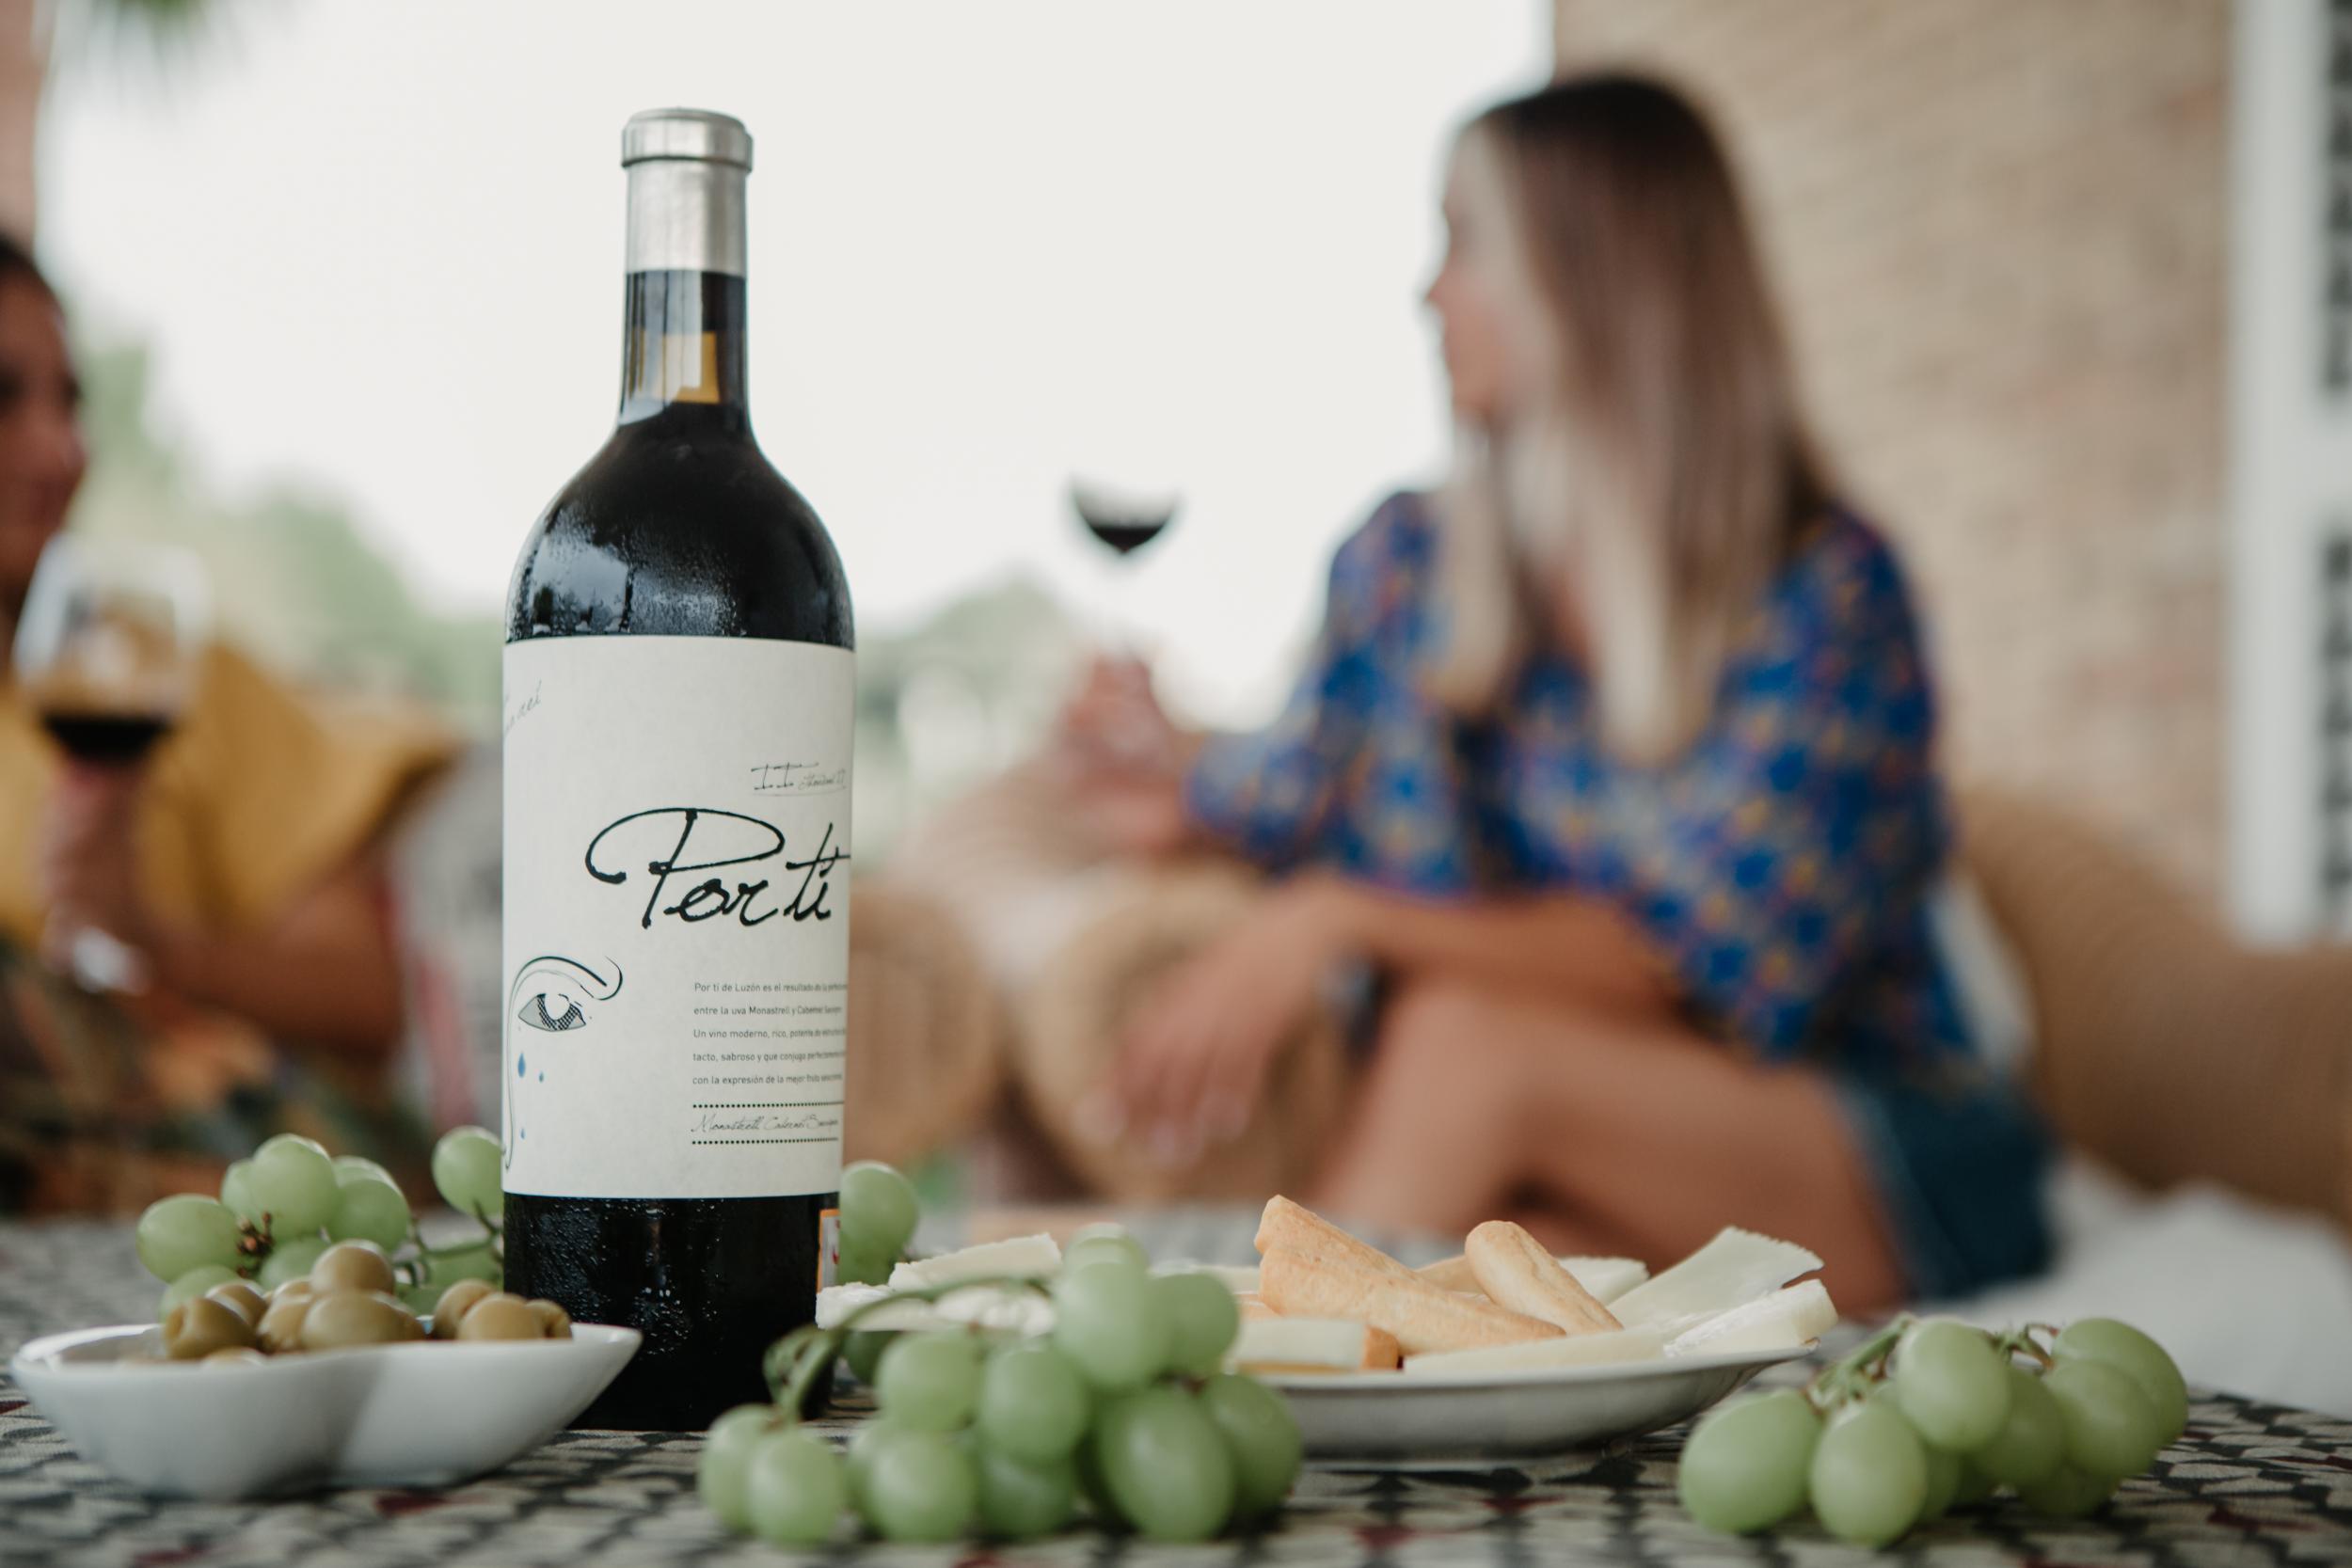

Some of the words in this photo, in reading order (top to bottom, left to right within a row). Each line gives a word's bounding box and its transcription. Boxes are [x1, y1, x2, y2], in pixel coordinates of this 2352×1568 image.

[585, 807, 785, 928] Por
[694, 982, 711, 992] Por
[722, 982, 733, 992] de
[735, 982, 759, 992] Luzón
[774, 982, 781, 991] el
[693, 1006, 718, 1015] entre
[721, 1006, 729, 1015] la
[749, 1006, 790, 1015] Monastrell
[791, 1008, 796, 1017] y
[693, 1028, 707, 1038] Un
[708, 1029, 727, 1038] vino
[730, 1029, 770, 1039] moderno,
[692, 1053, 718, 1062] tacto,
[721, 1053, 755, 1062] sabroso
[757, 1053, 762, 1063] y
[764, 1053, 778, 1063] que
[692, 1076, 709, 1085] con
[711, 1075, 720, 1085] la
[723, 1075, 763, 1086] expresión
[766, 1075, 775, 1085] de
[777, 1074, 785, 1084] la
